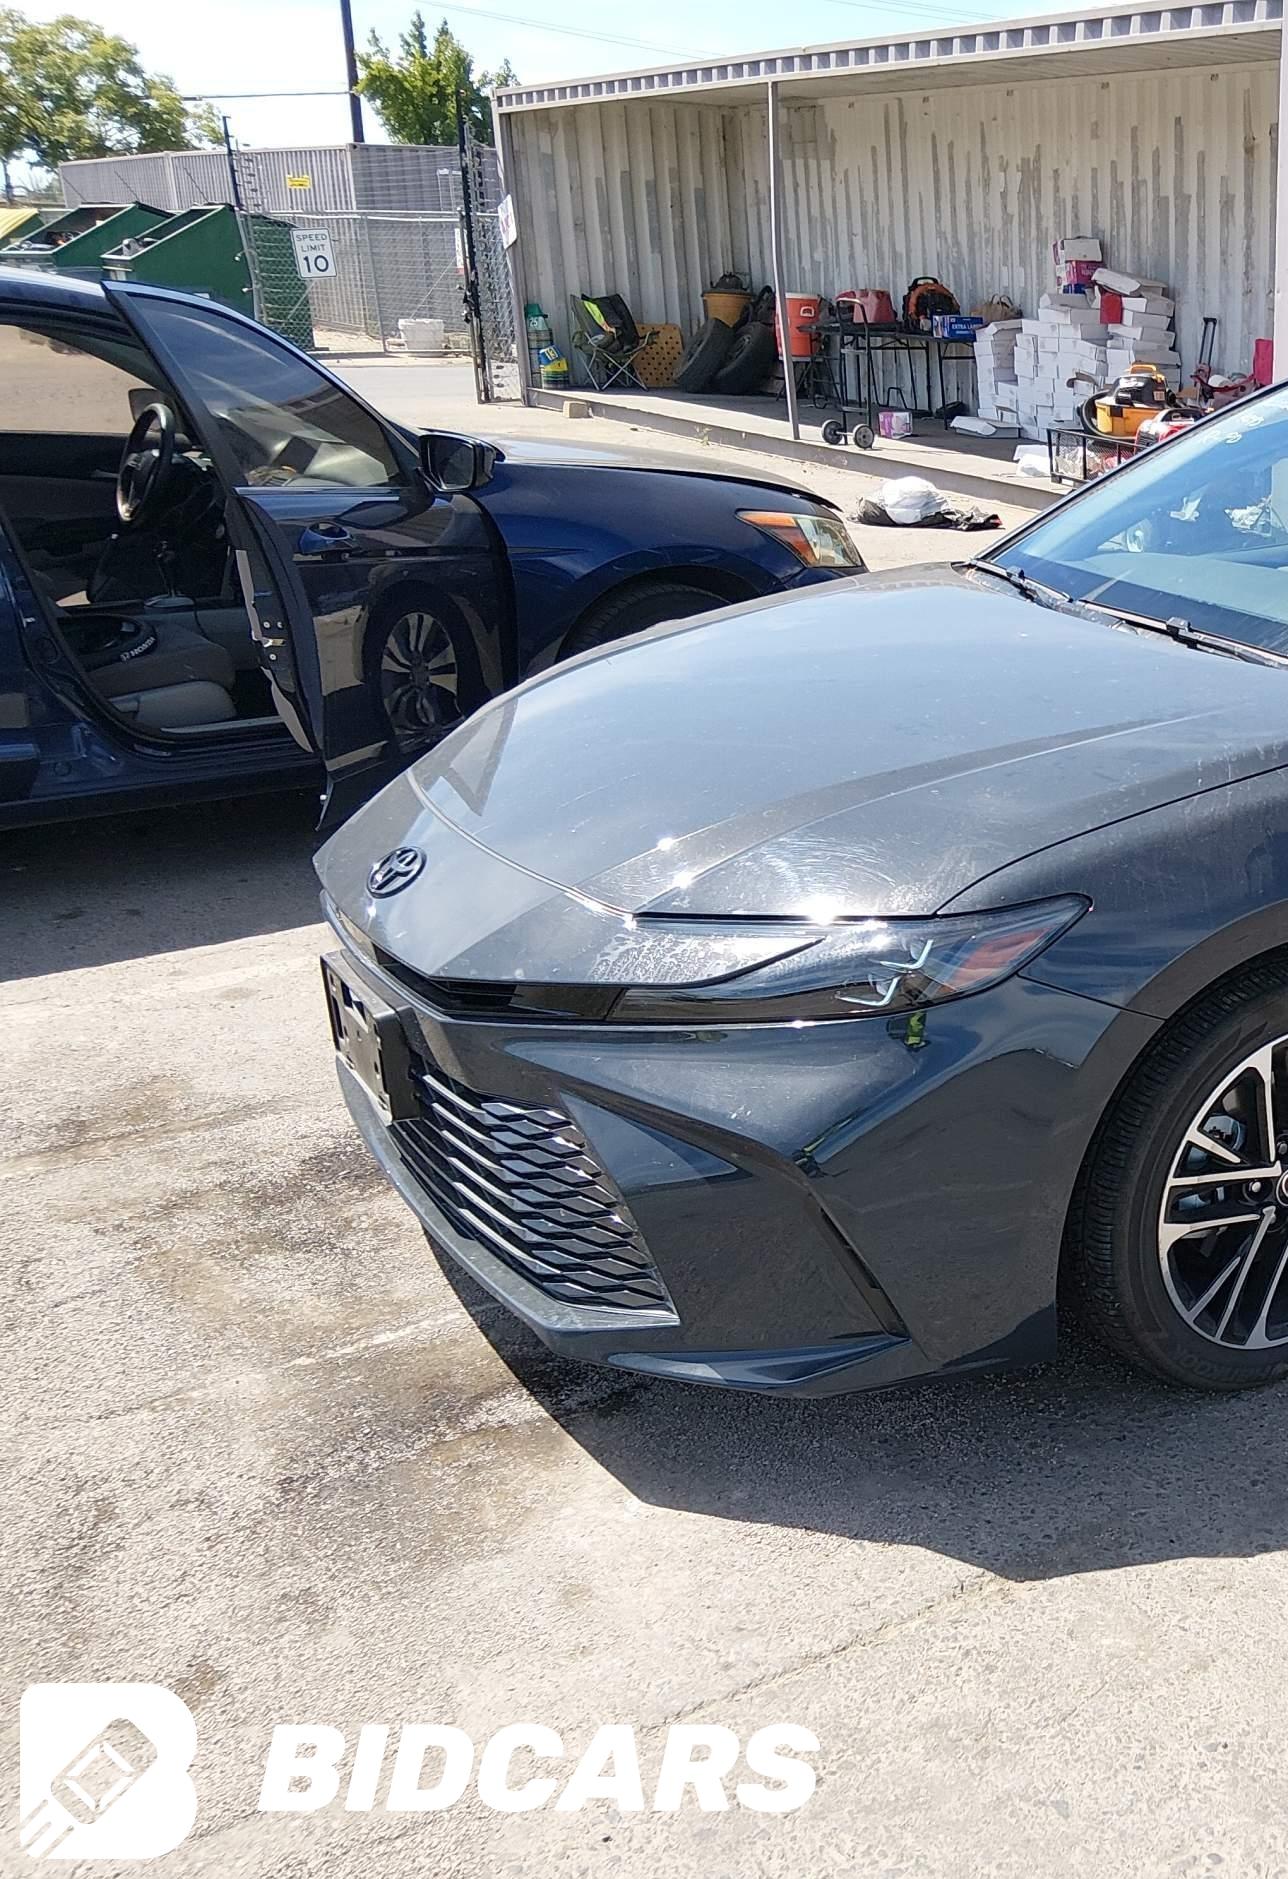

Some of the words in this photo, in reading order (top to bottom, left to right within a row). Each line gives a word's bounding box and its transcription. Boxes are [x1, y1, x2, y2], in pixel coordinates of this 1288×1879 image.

[296, 233, 328, 242] SPEED
[301, 244, 326, 252] LIMIT
[303, 255, 329, 273] 10
